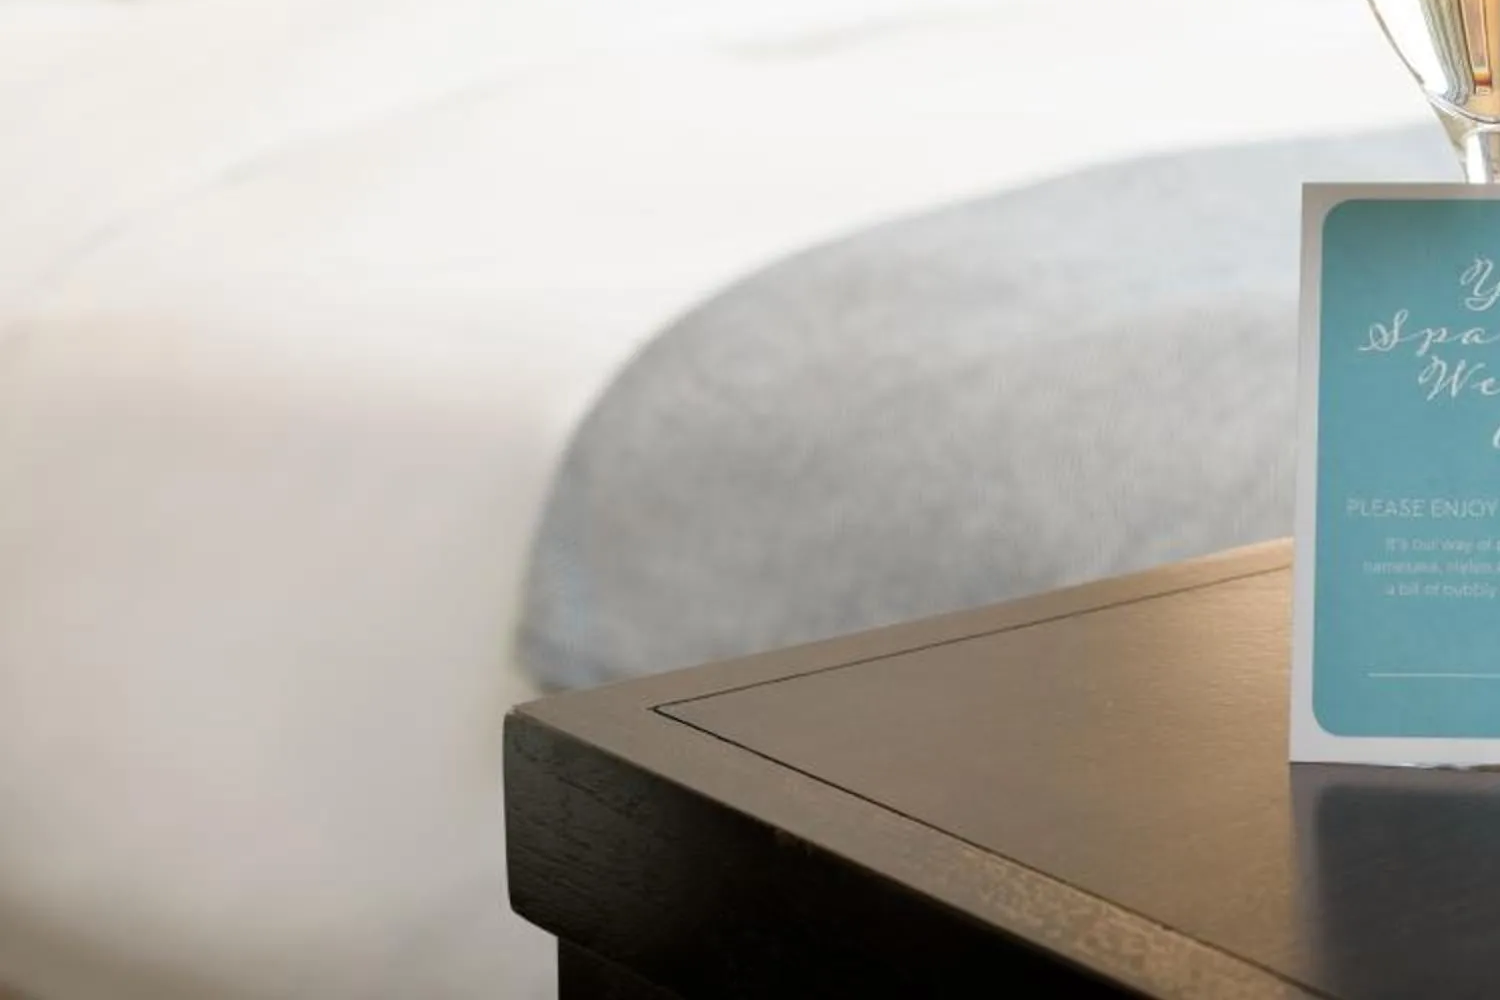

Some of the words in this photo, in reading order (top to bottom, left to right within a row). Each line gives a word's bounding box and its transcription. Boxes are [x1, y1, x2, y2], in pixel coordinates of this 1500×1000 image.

[1346, 499, 1426, 518] PLEASE
[1431, 499, 1498, 519] ENJOY
[1439, 539, 1473, 556] way
